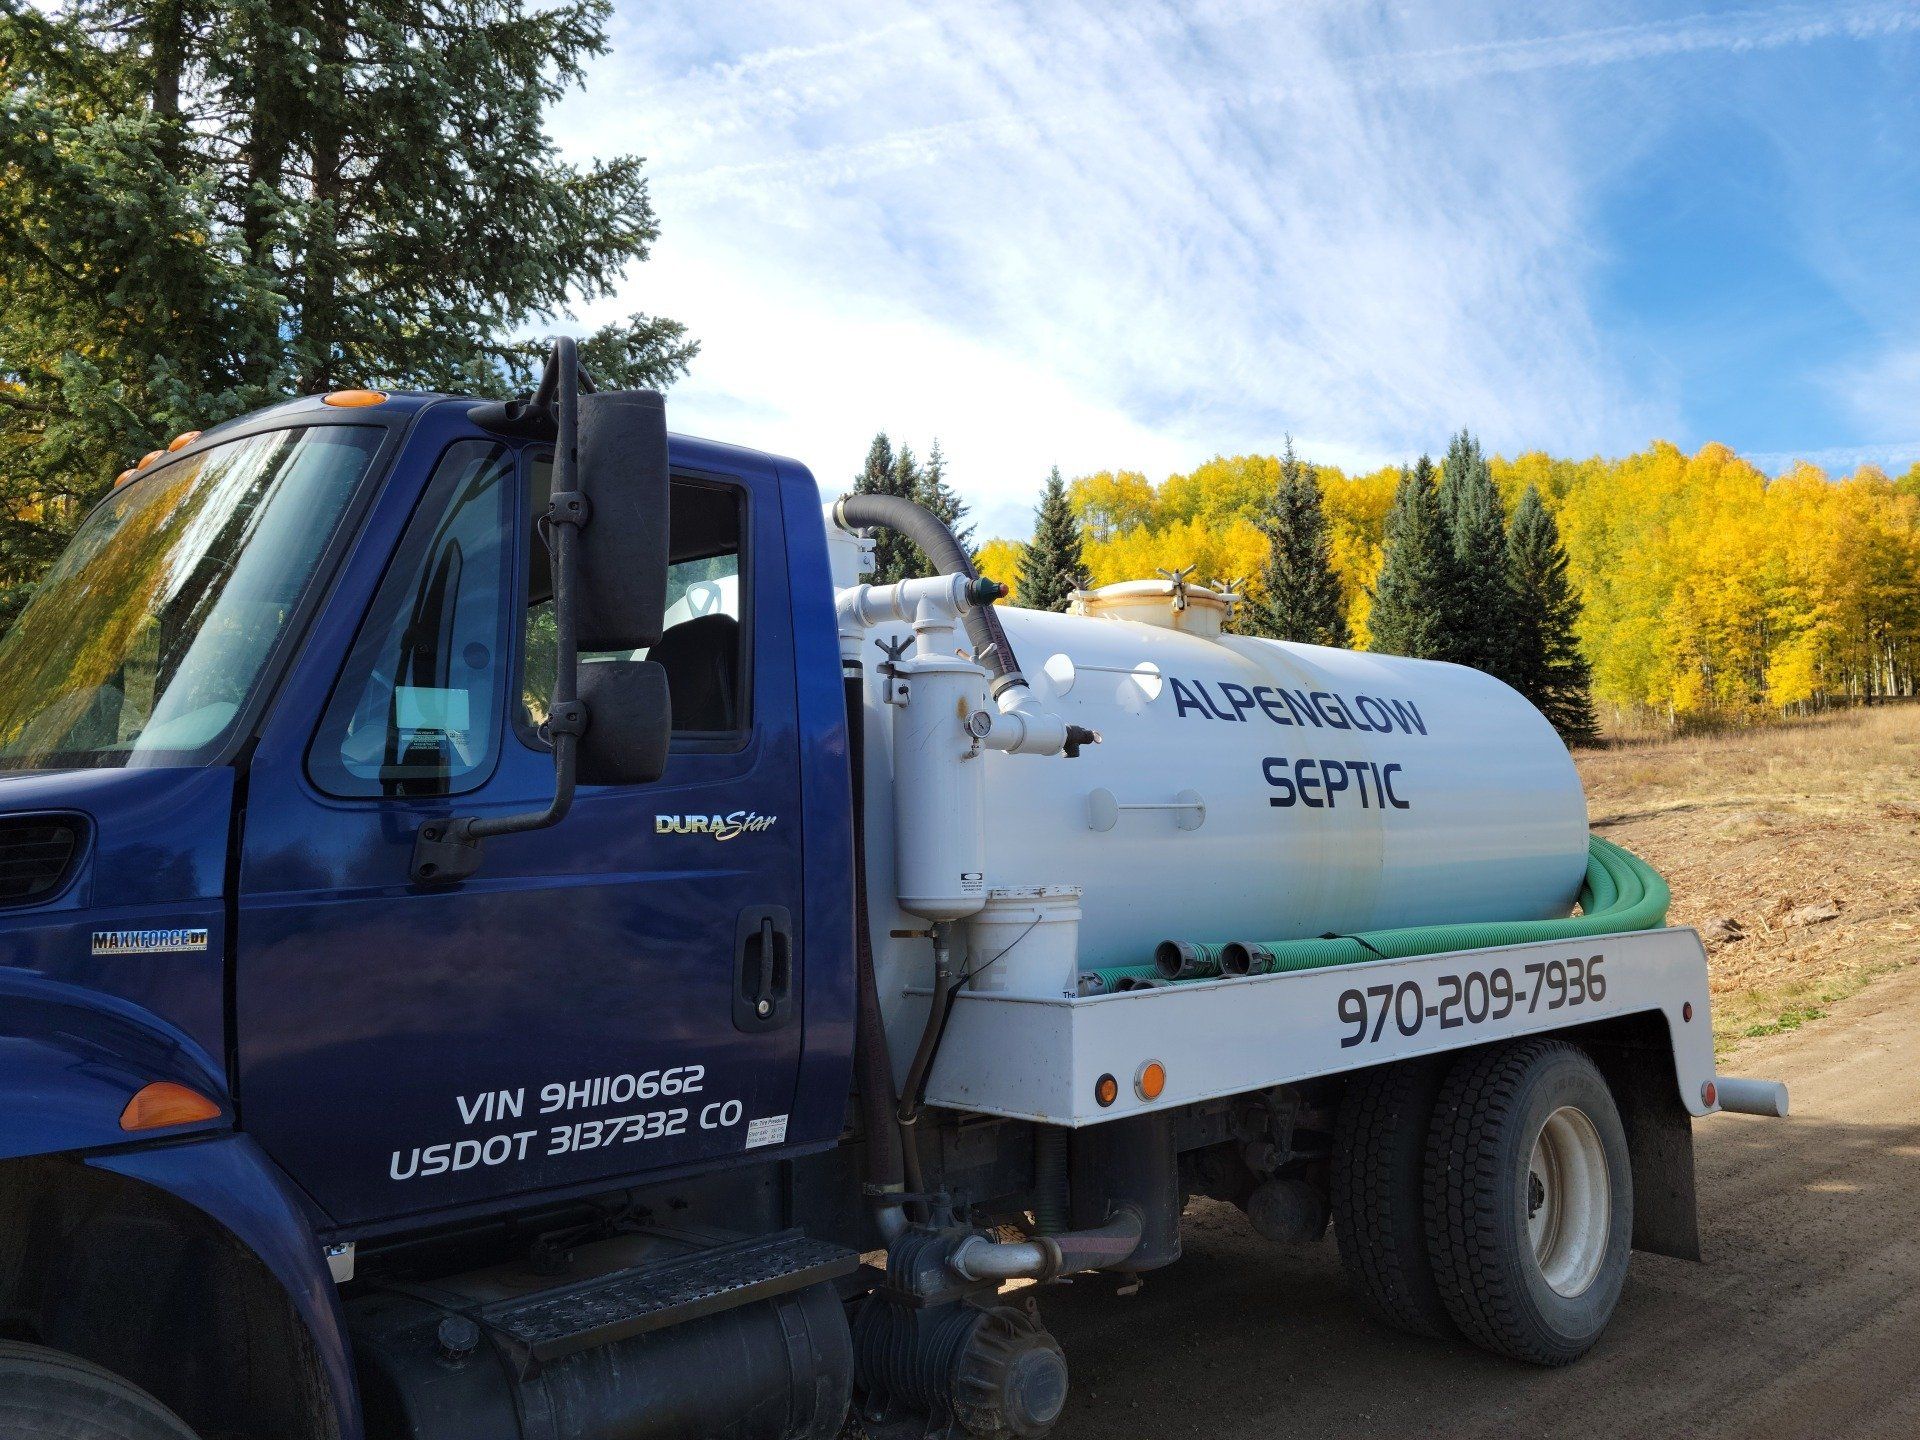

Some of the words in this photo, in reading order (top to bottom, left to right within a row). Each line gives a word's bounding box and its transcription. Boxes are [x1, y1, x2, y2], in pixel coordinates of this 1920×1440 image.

[1169, 677, 1428, 736] ALPENGLOW
[1262, 757, 1411, 808] SEPTIC
[93, 930, 189, 949] MAXXFORCE
[1063, 991, 1076, 999] The
[1338, 954, 1606, 1048] 970-209-7936
[456, 1087, 525, 1126] VIN
[540, 1065, 705, 1115] 9H110662
[389, 1131, 537, 1181] USDOT
[547, 1107, 690, 1157] 3137332
[700, 1099, 743, 1131] CO
